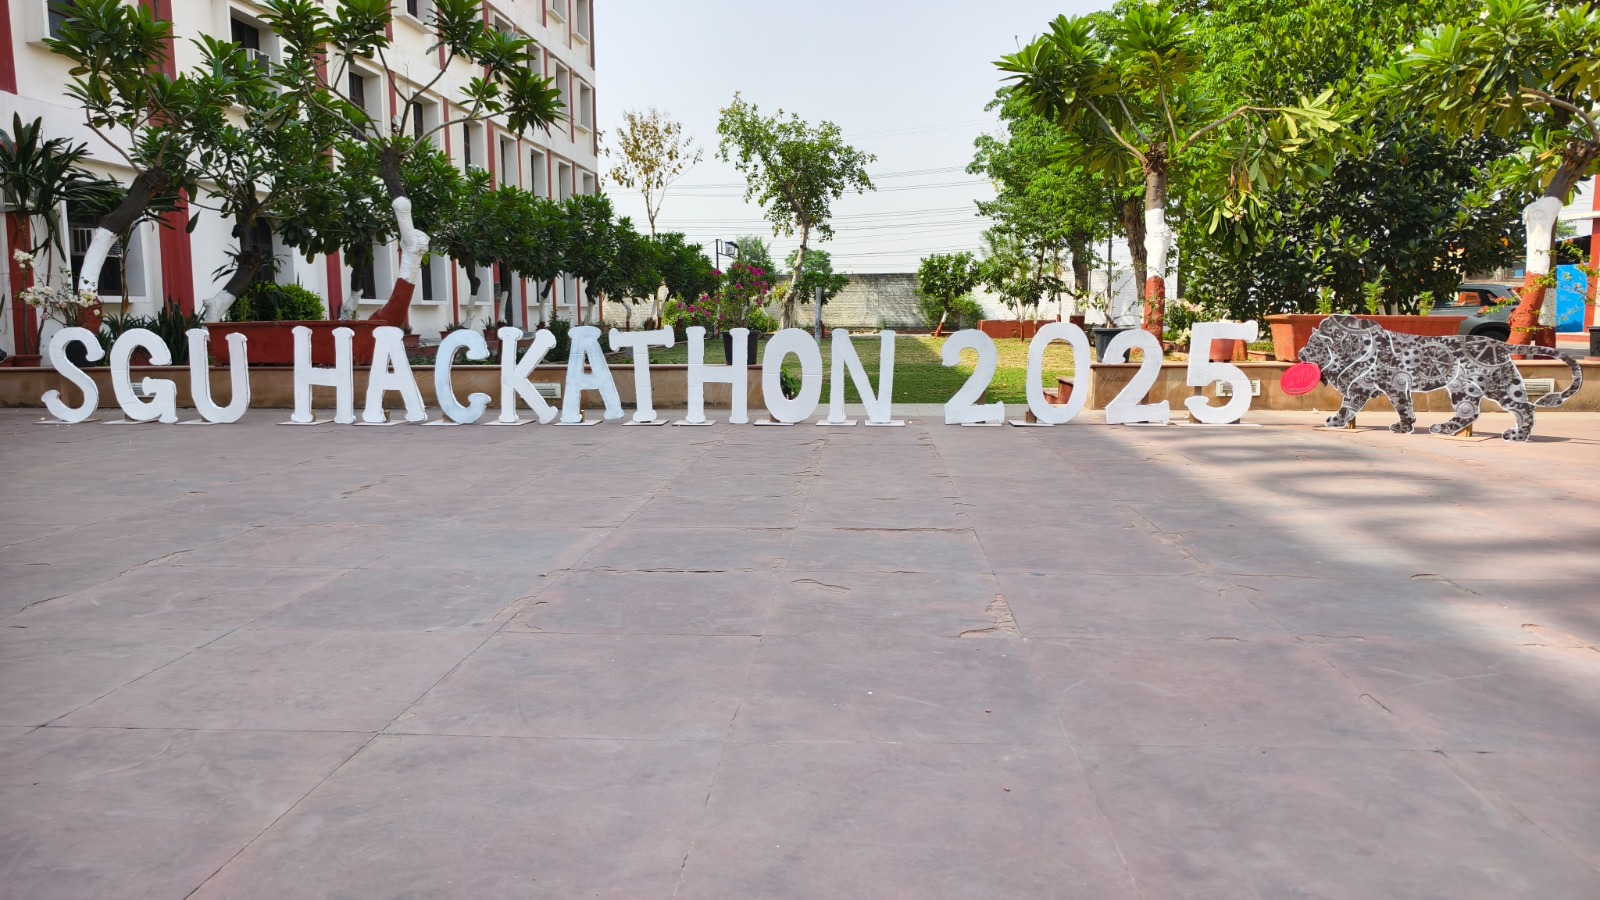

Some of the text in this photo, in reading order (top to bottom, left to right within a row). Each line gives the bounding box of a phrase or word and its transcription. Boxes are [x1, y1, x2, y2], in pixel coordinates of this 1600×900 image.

[41, 320, 1258, 424] SGU HACKATHON 2025
